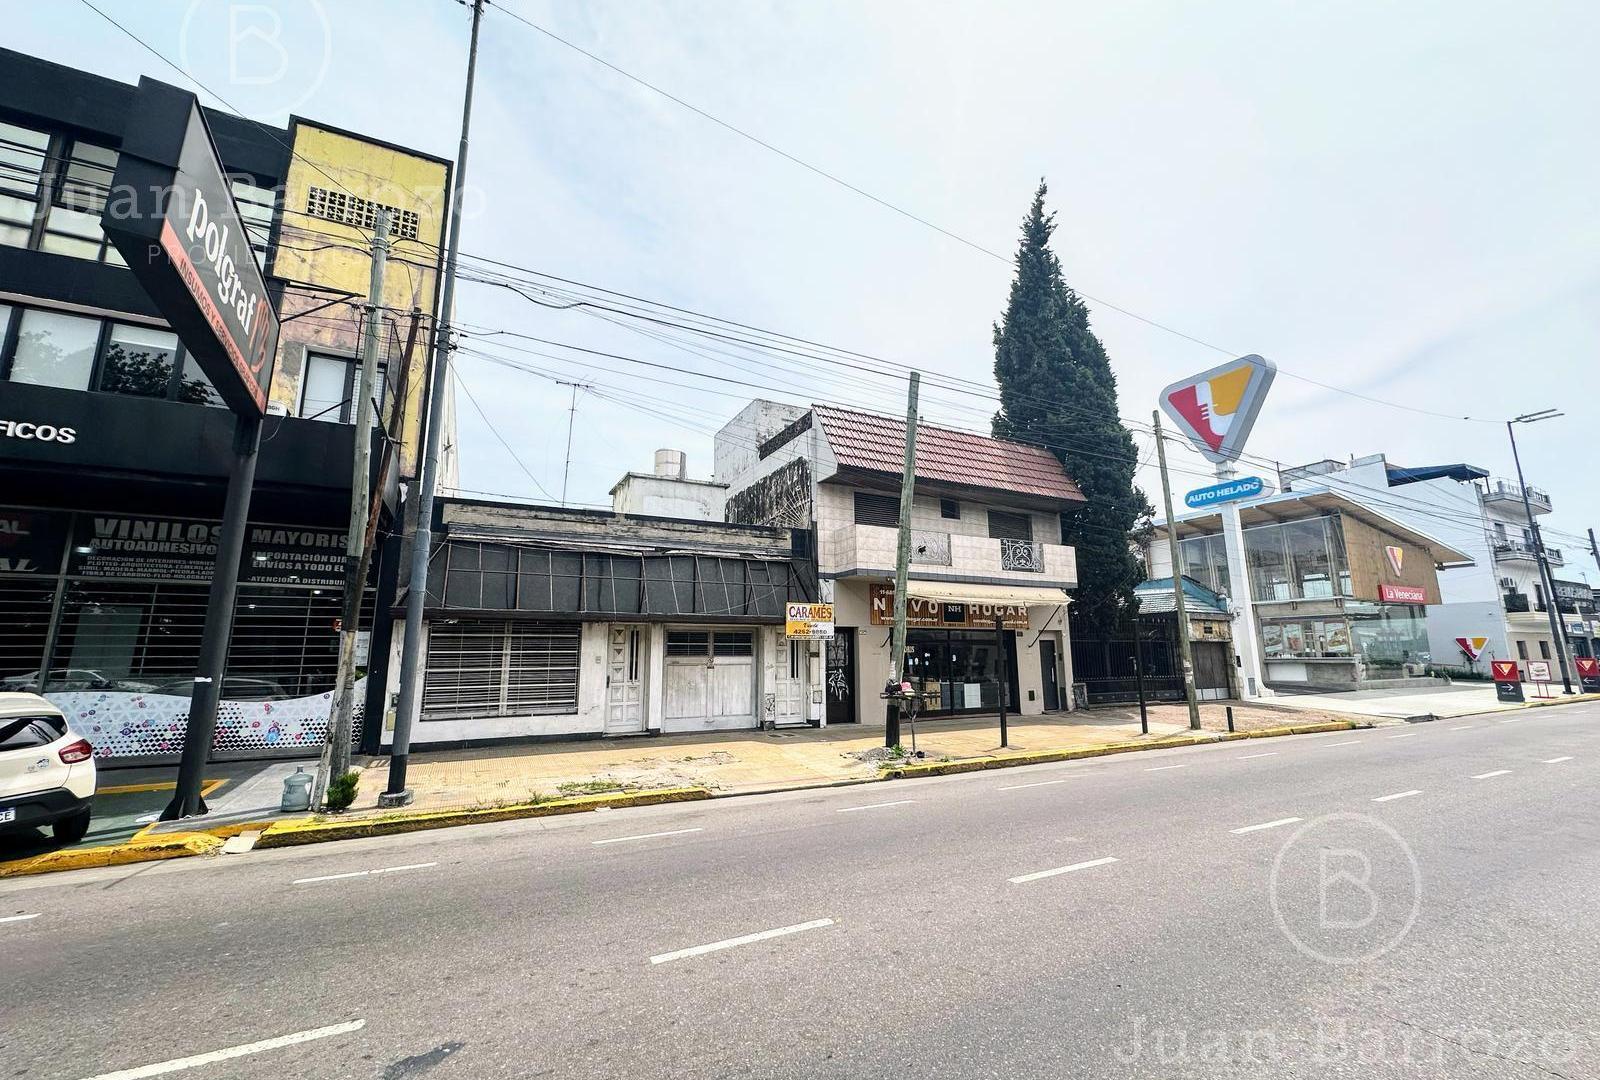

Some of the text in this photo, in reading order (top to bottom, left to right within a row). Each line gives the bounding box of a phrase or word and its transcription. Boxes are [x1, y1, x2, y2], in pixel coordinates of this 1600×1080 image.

[186, 188, 257, 336] polgraf
[1187, 482, 1260, 503] AUTO HELADO
[90, 538, 217, 555] AUTOADHESIVO
[304, 563, 332, 572] TODO
[1385, 587, 1394, 599] La
[947, 604, 962, 613] NH
[969, 603, 1027, 616] HOGAR
